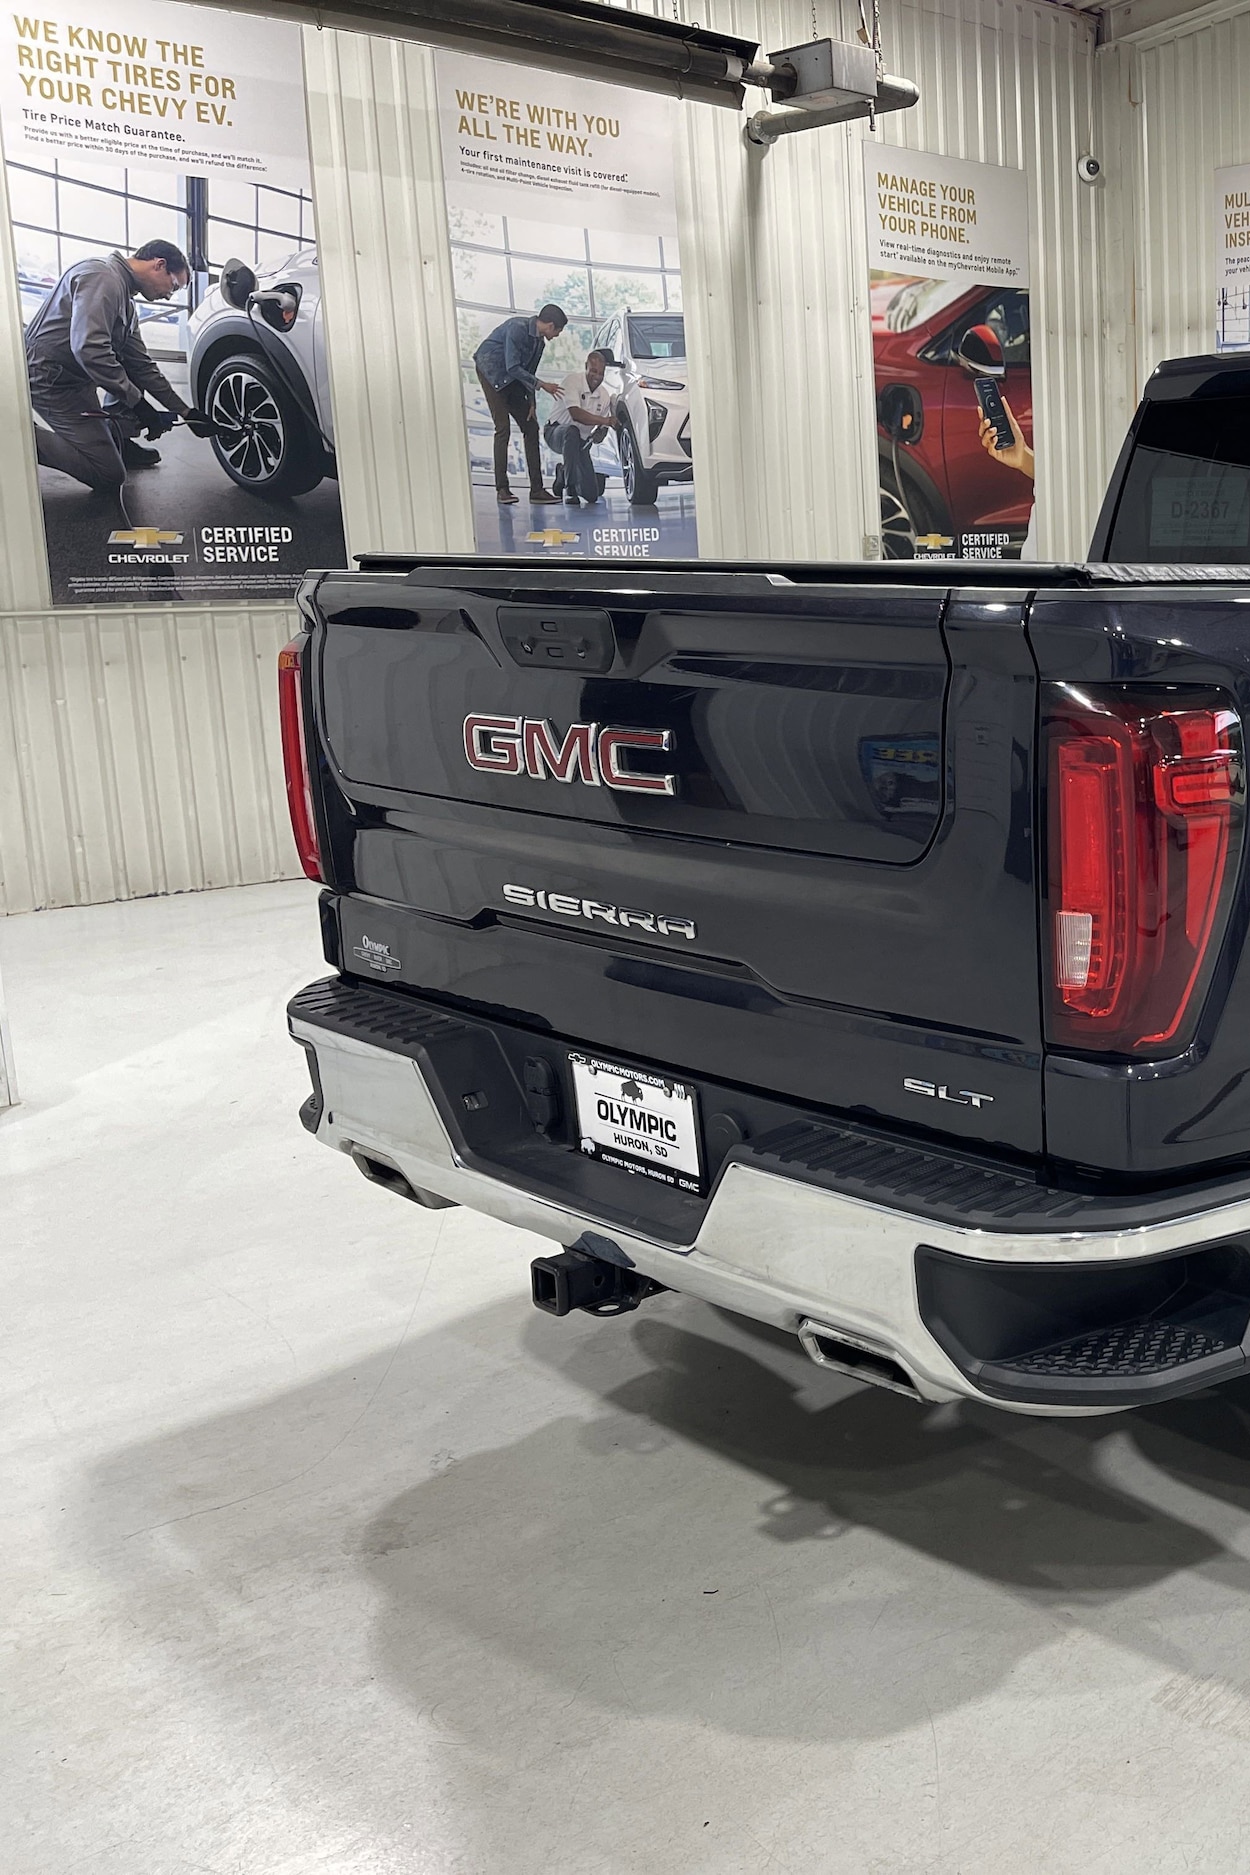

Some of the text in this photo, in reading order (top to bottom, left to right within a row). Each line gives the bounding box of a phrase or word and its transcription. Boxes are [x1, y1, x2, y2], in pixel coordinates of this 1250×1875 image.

[13, 14, 205, 68] WE KNOW THE
[17, 44, 236, 100] RIGHT TIRES FOR
[19, 73, 233, 127] YOUR CHEVY EV.
[455, 89, 620, 138] WE'RE WITH YOU
[22, 108, 186, 142] Tire Price Match Guarantee.
[458, 115, 593, 158] ALL THE WAY.
[24, 125, 49, 135] Provide
[59, 131, 73, 139] with
[80, 134, 99, 143] better
[100, 139, 123, 147] eligible
[124, 141, 139, 149] price
[181, 149, 210, 158] purchase,
[45, 136, 66, 146] better
[67, 141, 83, 149] price
[114, 148, 129, 156] days
[148, 153, 178, 162] purchase,
[205, 159, 225, 167] refund
[459, 145, 481, 158] Your
[483, 150, 503, 163] first
[505, 156, 562, 173] maintenance
[563, 165, 582, 176] visit
[583, 168, 591, 177] is
[877, 172, 976, 206] MANAGE YOUR
[877, 193, 977, 226] VEHICLE FROM
[879, 213, 970, 244] YOUR PHONE.
[879, 239, 1011, 265] View real-time diagnostics and enjoy remote
[899, 253, 927, 265] available
[936, 259, 947, 268] the
[948, 260, 985, 273] myChevrolet
[986, 265, 1004, 275] Mobile
[1225, 257, 1236, 265] The
[1225, 267, 1239, 276] your
[201, 526, 293, 544] CERTIFIED
[593, 527, 660, 543] CERTIFIED
[961, 533, 1009, 546] CERTIFIED
[108, 553, 189, 564] CHEVROLET
[203, 546, 280, 563] SERVICE
[594, 545, 650, 557] SERVICE
[962, 547, 1002, 559] SERVICE
[463, 712, 675, 796] GMC
[502, 883, 697, 940] SIERRA
[903, 1077, 994, 1108] SLT
[597, 1099, 677, 1142] OLYMPIC
[613, 1133, 668, 1158] HURON, SD
[601, 1153, 675, 1184] OLYMPIC MOTORS, HURON SD
[678, 1179, 700, 1192] GMC
